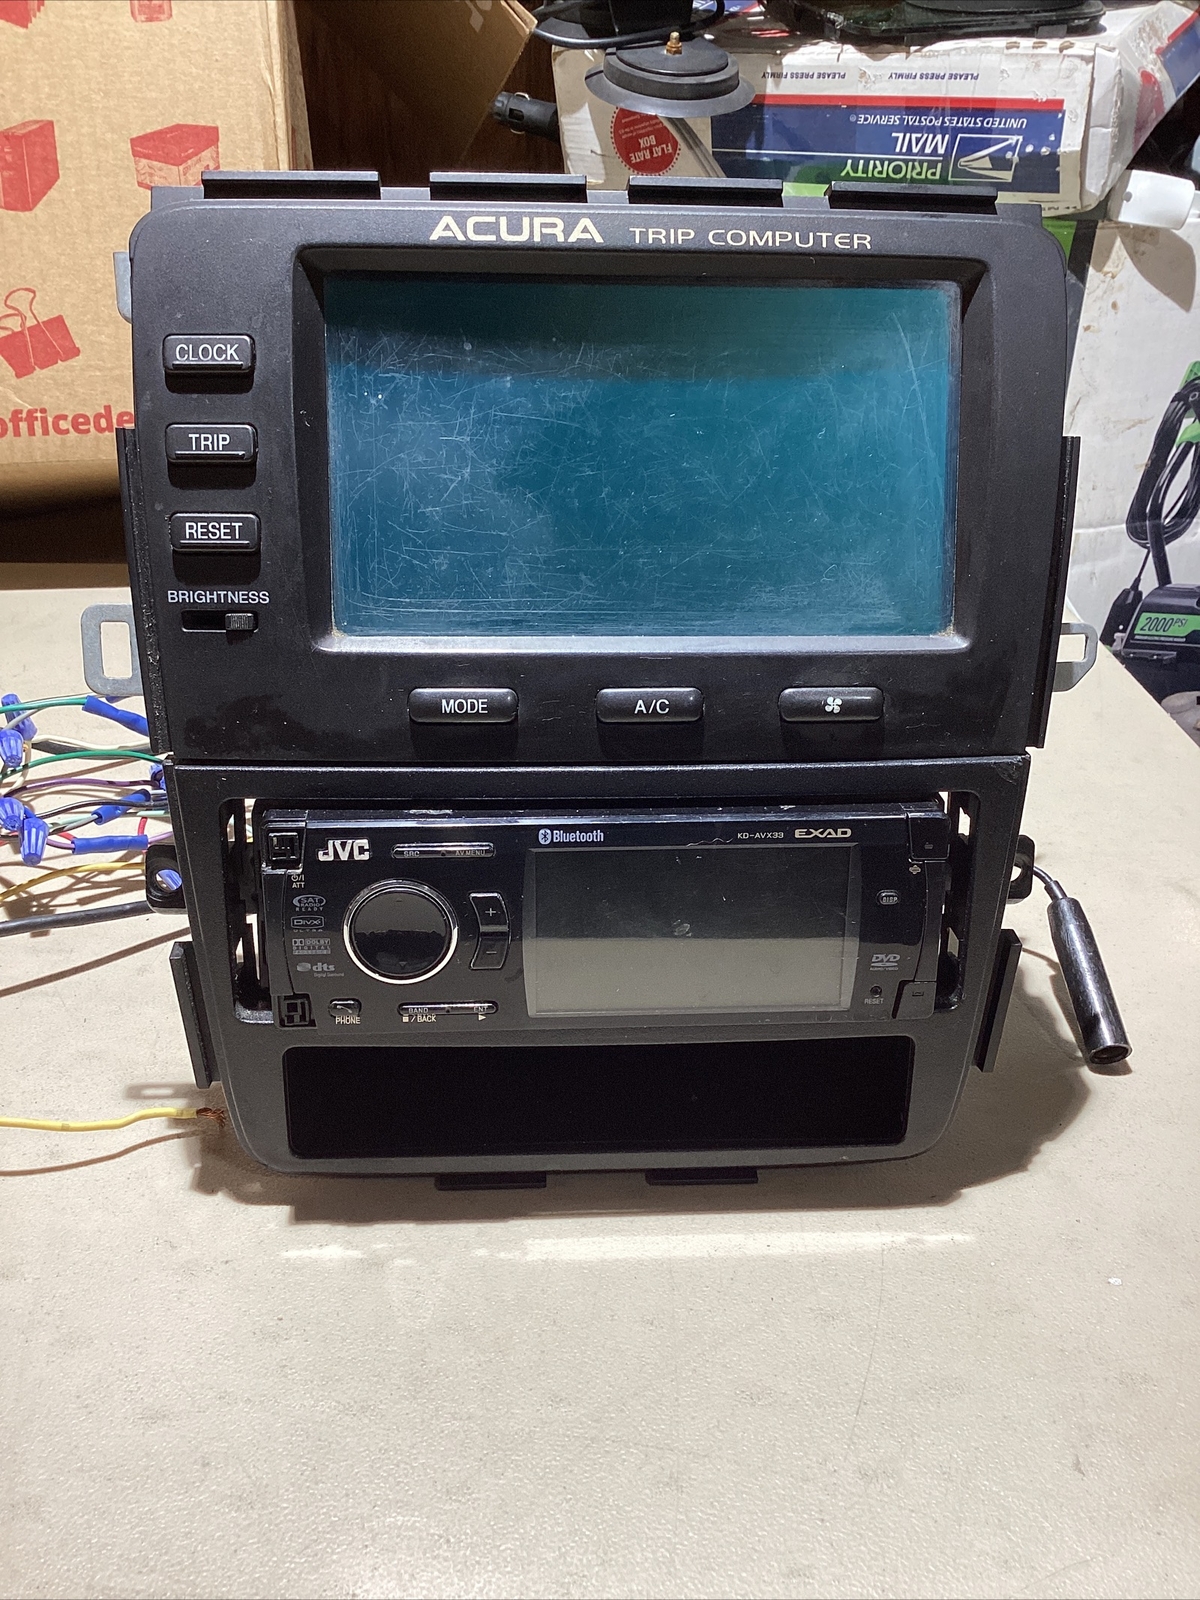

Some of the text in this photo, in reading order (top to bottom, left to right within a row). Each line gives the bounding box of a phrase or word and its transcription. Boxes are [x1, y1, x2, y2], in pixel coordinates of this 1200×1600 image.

[761, 71, 846, 79] PLEASE PRESS FIRMLY
[888, 71, 979, 81] PLEASE PRESS FIRMLY
[902, 115, 942, 127] POSTAL
[943, 116, 982, 128] STATES
[983, 117, 1027, 129] UNITED
[638, 134, 656, 149] BOX
[892, 132, 949, 154] MAIL
[629, 142, 673, 164] FLAT RATE
[840, 158, 943, 180] PRIORITY
[429, 215, 872, 250] ACURA TRIP COMPUTER
[175, 343, 240, 361] CLOCK
[188, 433, 230, 451] TRIP
[185, 522, 243, 540] RESET
[167, 590, 270, 604] BRIGHTNESS
[441, 699, 488, 714] MODE
[634, 700, 670, 714] A/C
[553, 829, 604, 843] Bluetooth
[737, 828, 852, 839] KD-AVX33 EXAD
[318, 839, 370, 861] JVC
[403, 850, 420, 858] SRC
[871, 953, 900, 962] DVD
[312, 962, 335, 971] dts
[335, 1015, 361, 1024] PHONE
